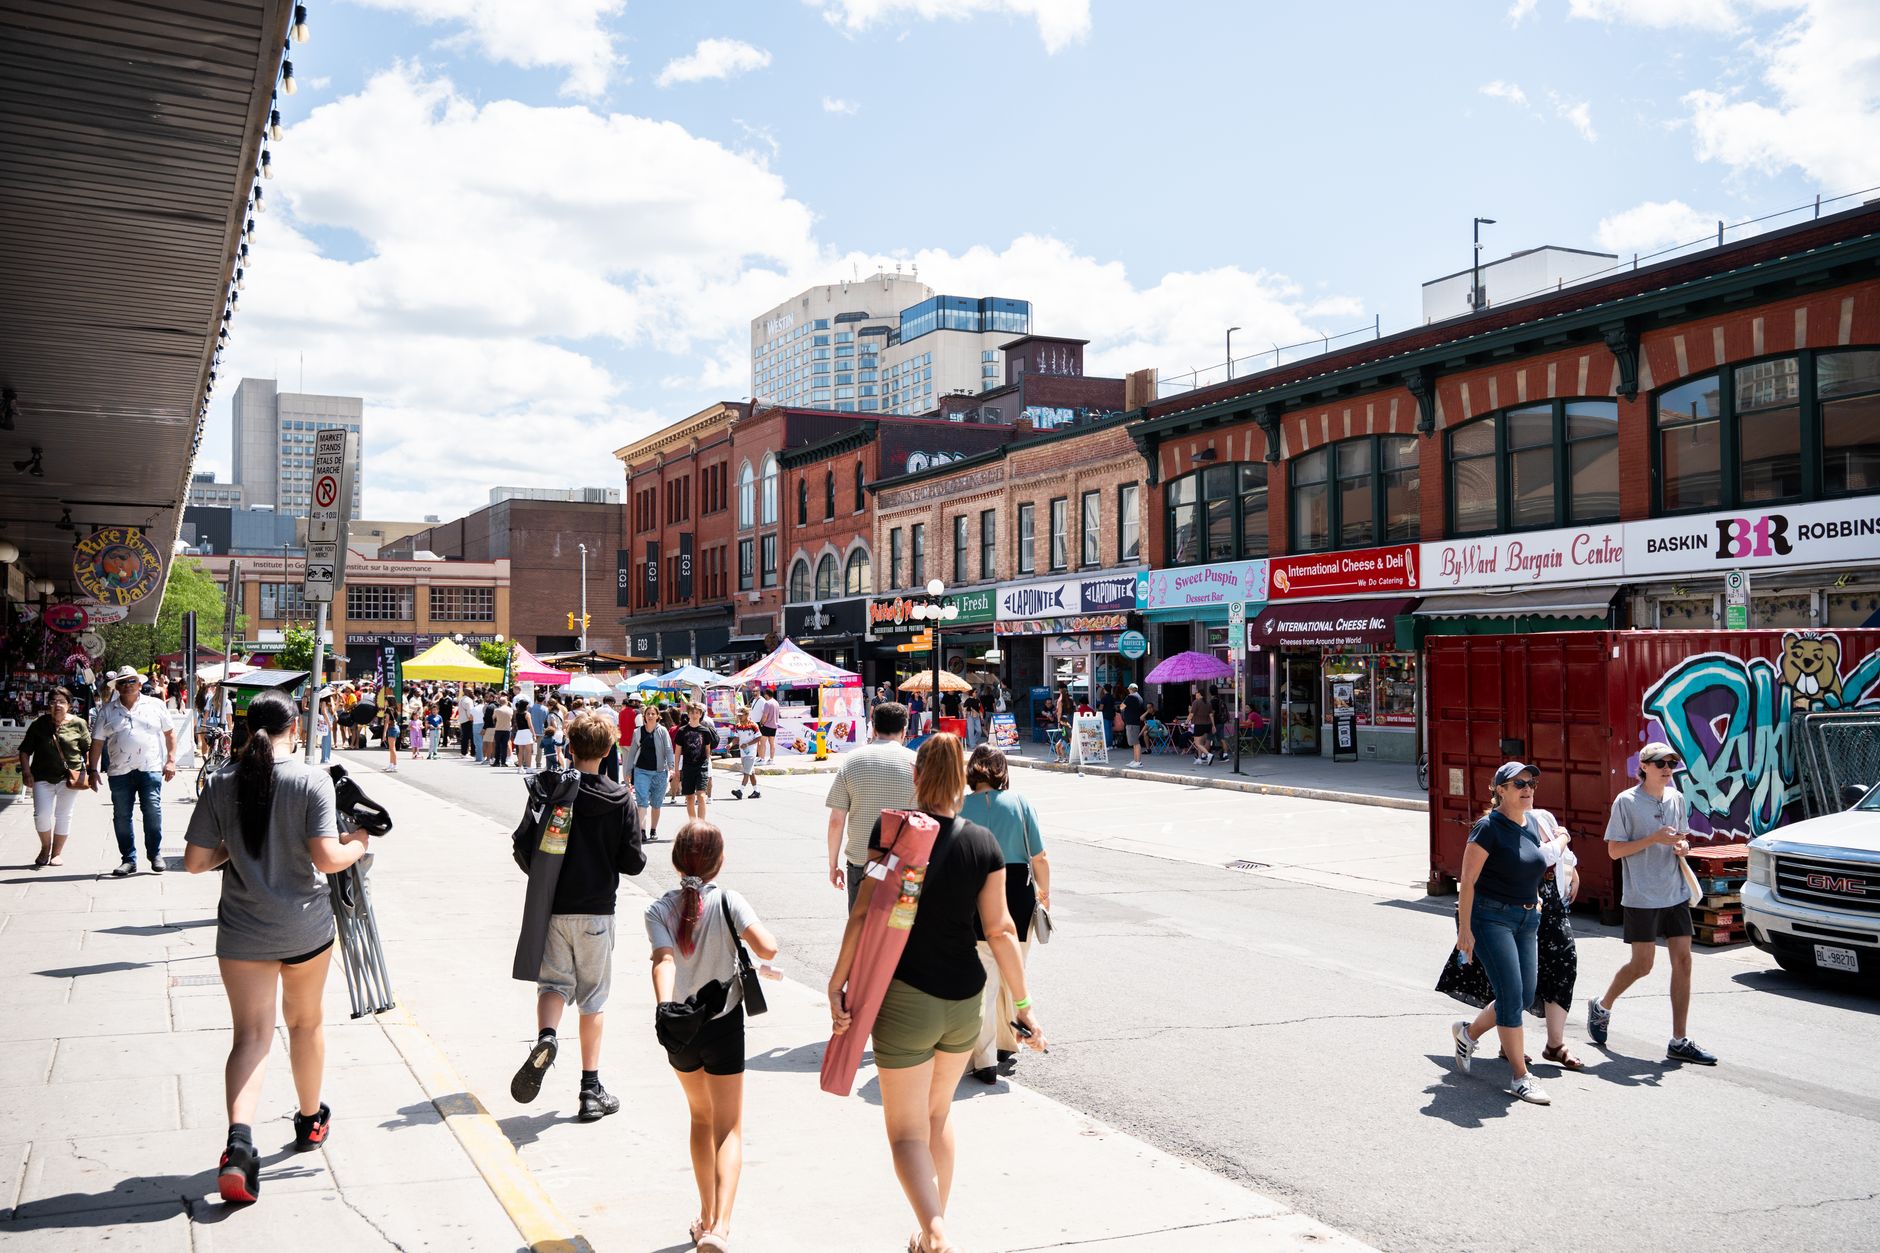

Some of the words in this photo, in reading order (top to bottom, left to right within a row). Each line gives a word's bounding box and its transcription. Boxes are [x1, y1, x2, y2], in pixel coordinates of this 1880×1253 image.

[767, 312, 794, 337] WESTIN
[320, 434, 343, 442] MARKET
[320, 444, 341, 452] STANDS
[76, 528, 120, 556] Pure
[1648, 534, 1708, 554] BASKIN
[1798, 518, 1880, 541] ROBBINS
[253, 561, 283, 569] Institute
[682, 554, 691, 576] EQ3
[1288, 560, 1340, 578] International
[1342, 558, 1375, 572] Cheese
[1376, 558, 1384, 569] &
[1386, 554, 1404, 568] Deli
[1505, 541, 1562, 580] Bargain
[1572, 533, 1623, 566] Centre
[618, 568, 627, 588] EQ3
[648, 561, 657, 582] EQ3
[1175, 572, 1203, 591] Sweet
[1204, 568, 1238, 587] Puspin
[1378, 577, 1404, 585] Catering
[73, 563, 110, 604] Juice
[116, 580, 148, 606] Bar
[1092, 582, 1126, 604] LAPOINTE
[962, 594, 989, 612] Fresh
[1012, 588, 1054, 616] LAPOINTE
[1186, 594, 1210, 603] Dessert
[1212, 592, 1224, 602] Bar
[1276, 620, 1334, 632] INTERNATIONAL
[1336, 618, 1367, 630] CHEESE
[1368, 617, 1386, 630] INC.
[638, 638, 648, 651] EQ3
[385, 646, 396, 688] ENTER
[1806, 873, 1867, 895] GMC
[1816, 950, 1827, 962] BL
[1830, 952, 1856, 966] 98270
